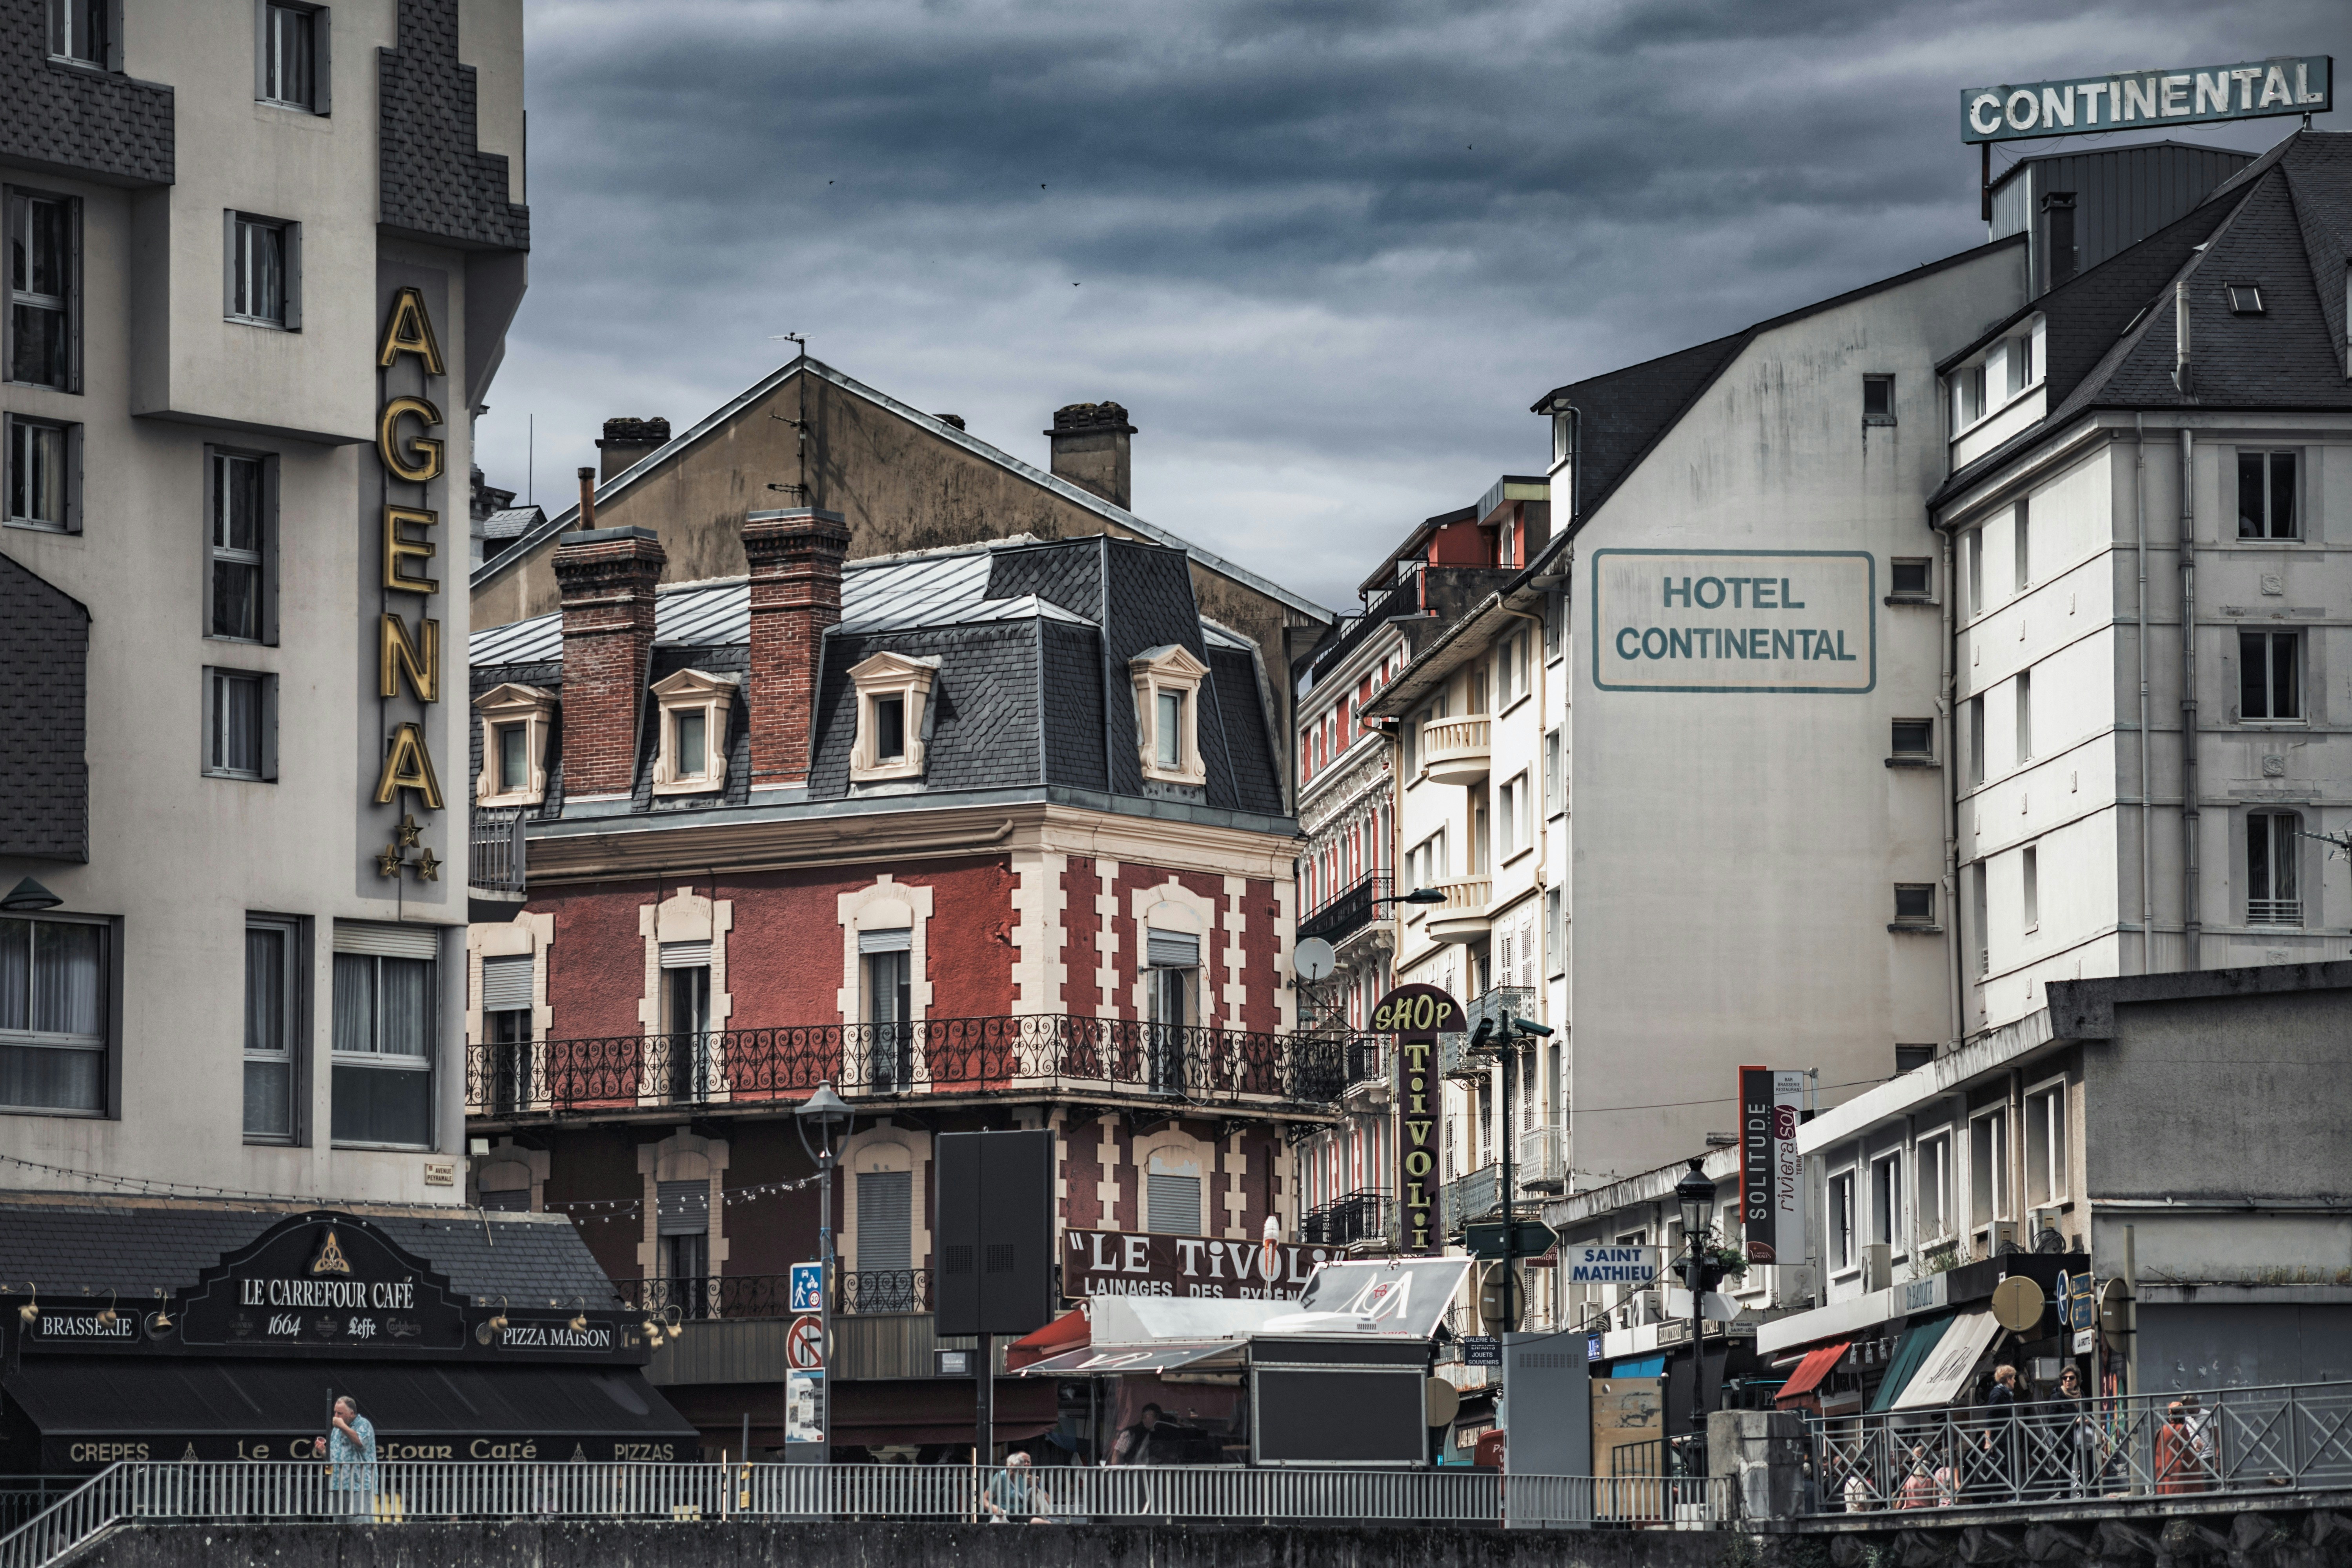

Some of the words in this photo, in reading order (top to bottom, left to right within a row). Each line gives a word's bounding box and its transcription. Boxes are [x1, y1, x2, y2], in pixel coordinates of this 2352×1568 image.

[1970, 62, 2324, 135] CONTINENTAL
[374, 285, 447, 810] AGENA
[1664, 576, 1805, 609] HOTEL
[1616, 627, 1857, 661] CONTINENTAL
[1375, 994, 1451, 1030] SHOP
[1749, 1104, 1766, 1219] SOLITUDE
[1777, 1142, 1794, 1211] riviera
[1585, 1249, 1642, 1262] SAINT
[1085, 1277, 1172, 1297] LAINAGES
[1189, 1284, 1223, 1299] DES
[1573, 1266, 1653, 1280] MATHIEU
[243, 1279, 264, 1305] LE
[270, 1280, 367, 1308] CARREFOUR
[373, 1276, 413, 1309] CAFÉ
[268, 1313, 301, 1336] 1664
[348, 1317, 377, 1339] Leffe
[386, 1317, 421, 1335] Carlsberg
[502, 1328, 548, 1346] PIZZA
[550, 1329, 610, 1346] MAISON
[1659, 1324, 1682, 1343] BIJOUTERIE
[70, 1442, 149, 1462] CREPES
[237, 1439, 269, 1462] Le
[471, 1438, 537, 1462] Café
[615, 1444, 674, 1461] PIZZAS
